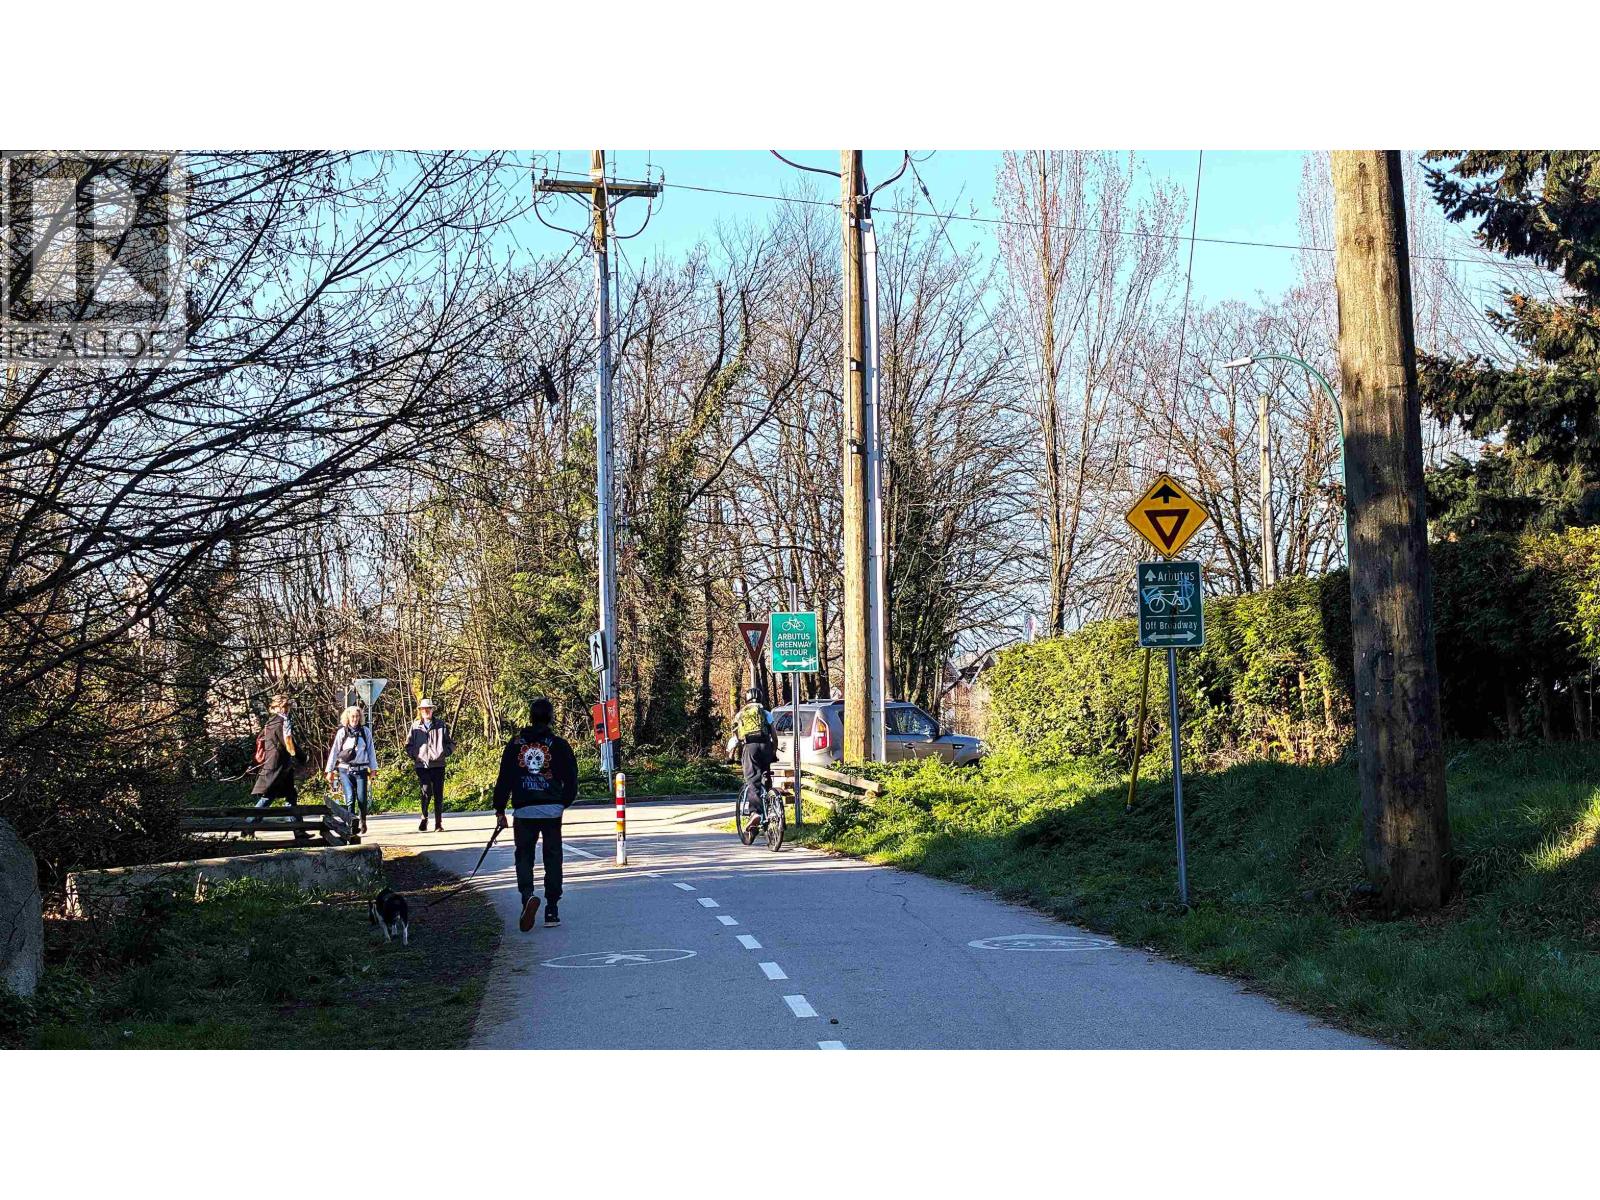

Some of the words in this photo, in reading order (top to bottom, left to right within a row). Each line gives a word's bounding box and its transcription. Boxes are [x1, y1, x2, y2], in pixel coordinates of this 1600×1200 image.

[1158, 571, 1195, 581] Arbutus
[1160, 620, 1198, 631] Broadway
[777, 632, 811, 641] ARBUTUS
[775, 641, 813, 649] GREENWAY
